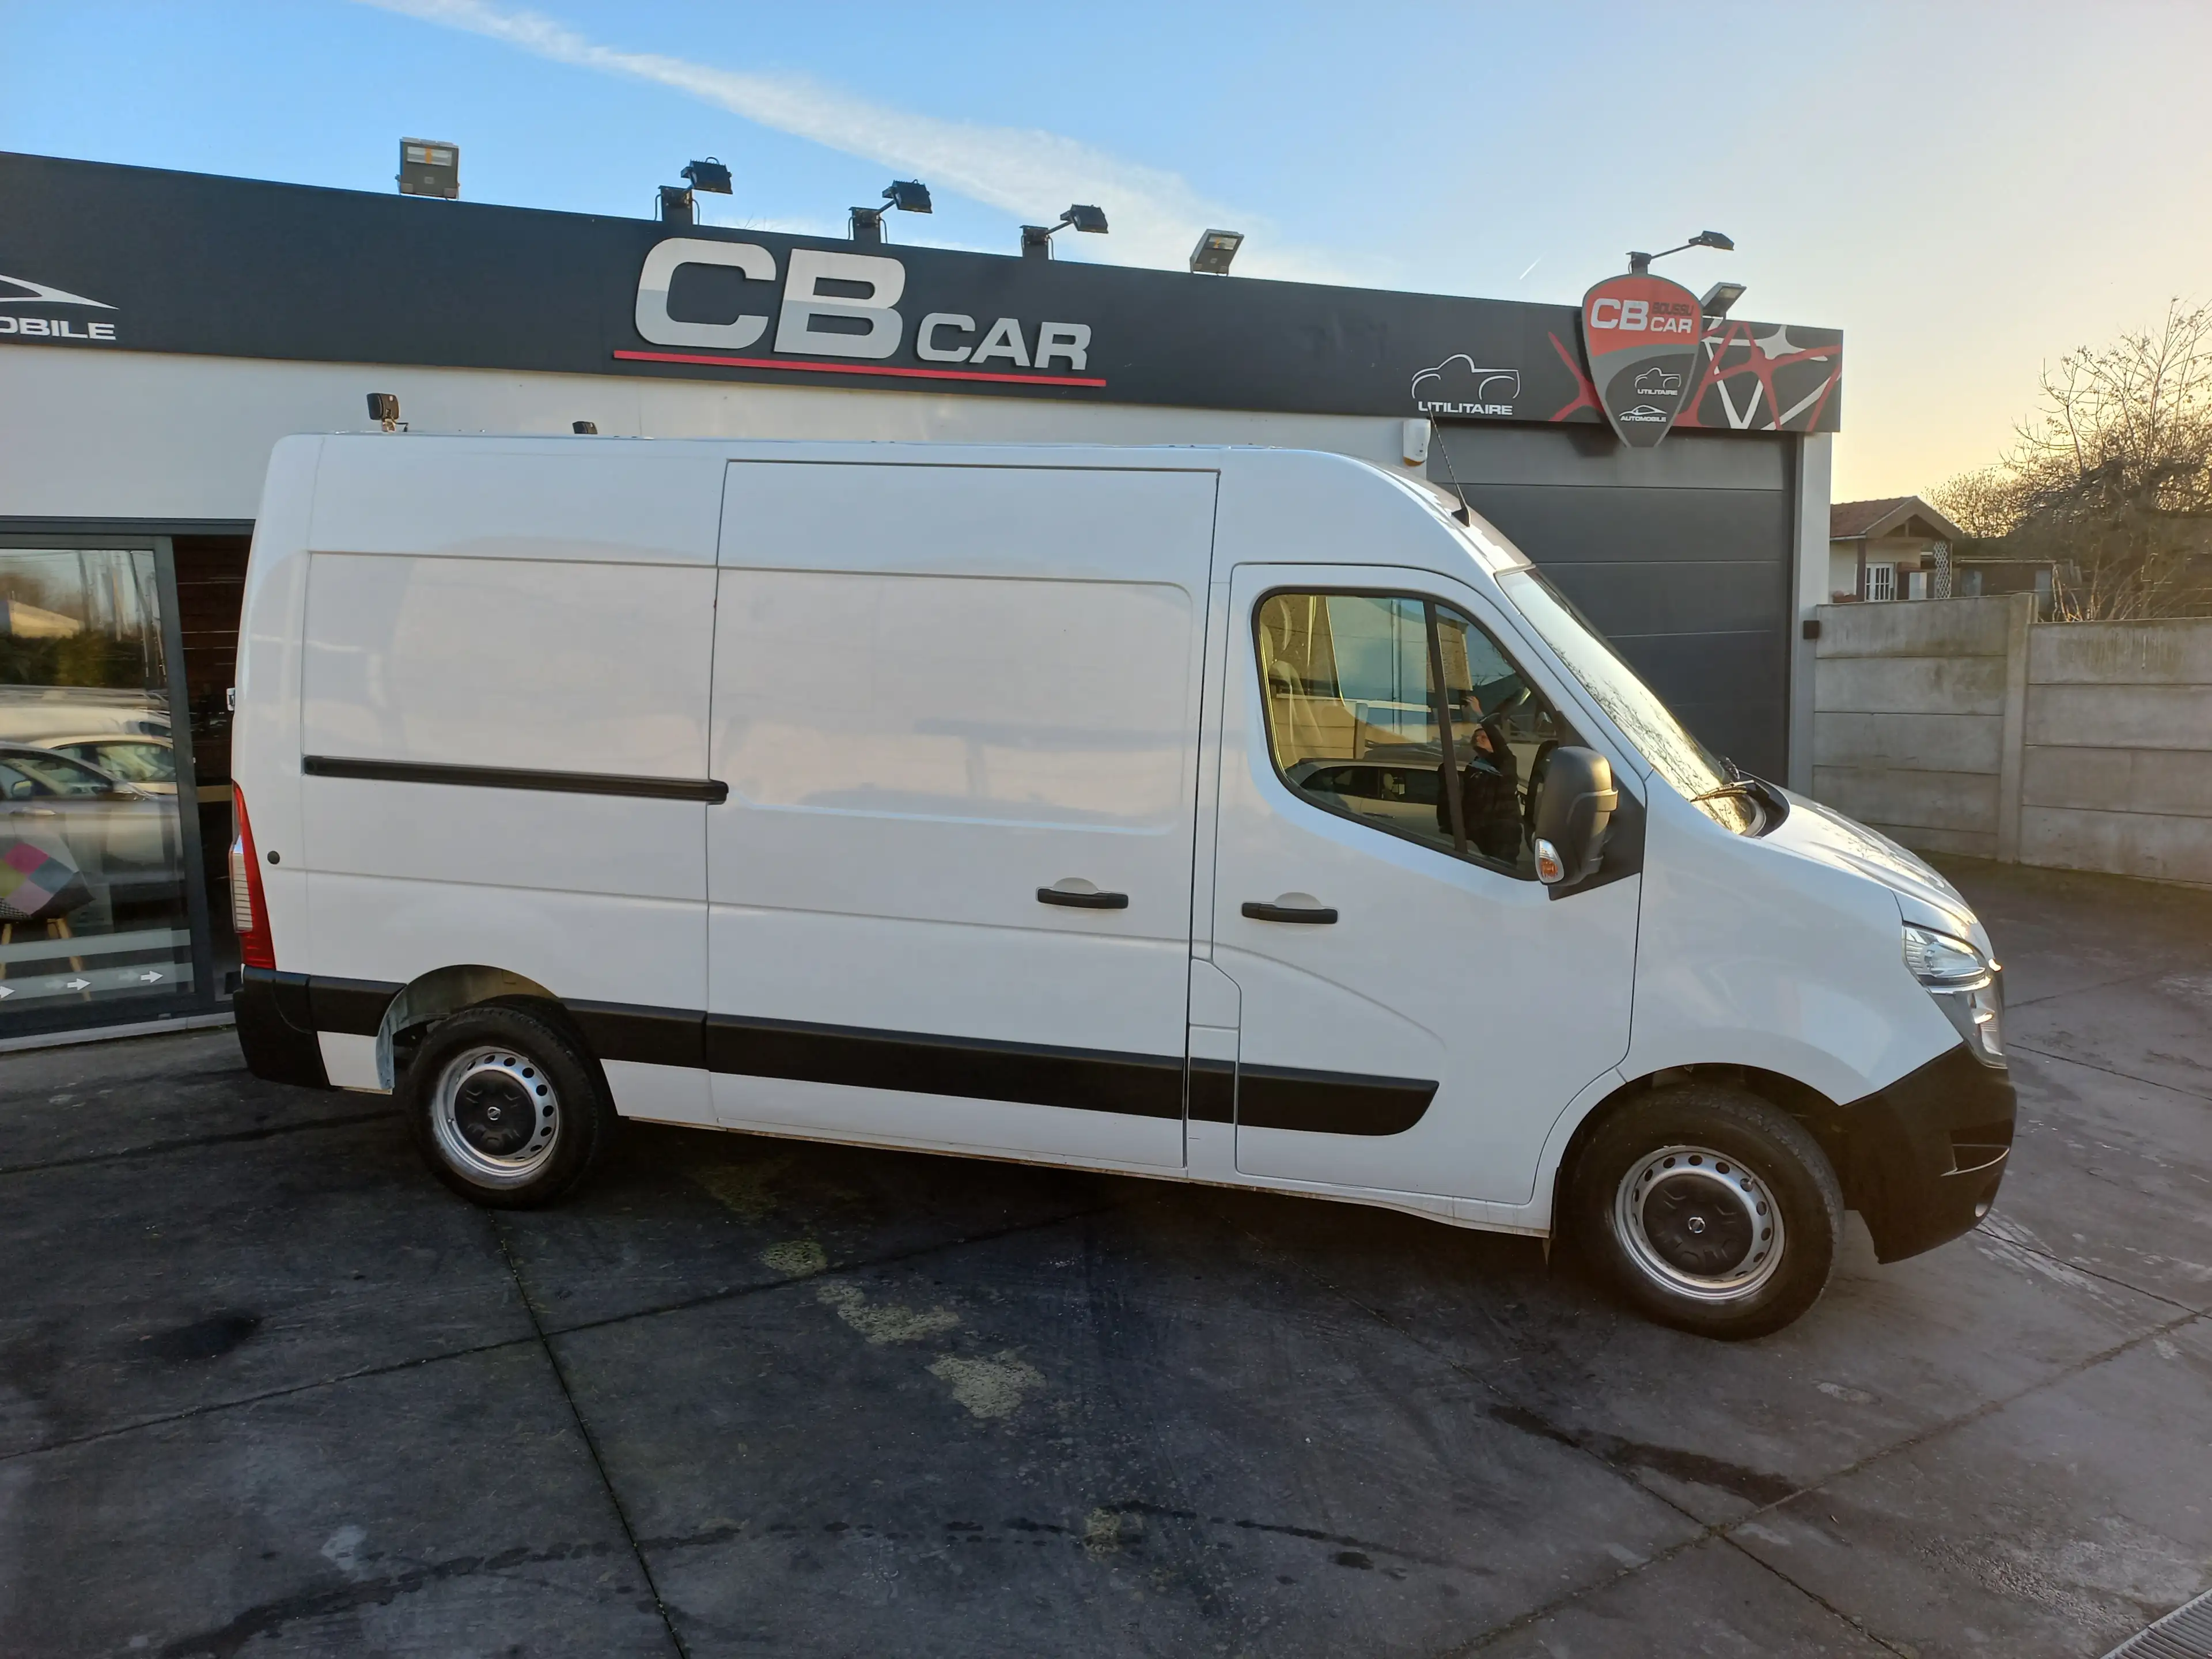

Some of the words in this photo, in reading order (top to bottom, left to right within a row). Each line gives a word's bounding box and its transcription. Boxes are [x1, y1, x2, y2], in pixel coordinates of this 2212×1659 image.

[635, 237, 906, 359] CB
[916, 312, 1092, 370] CAR
[1652, 302, 1695, 316] BOUSSU
[1590, 298, 1649, 331] CB
[1650, 317, 1692, 334] CAR
[1418, 401, 1513, 415] UTILITAIRE
